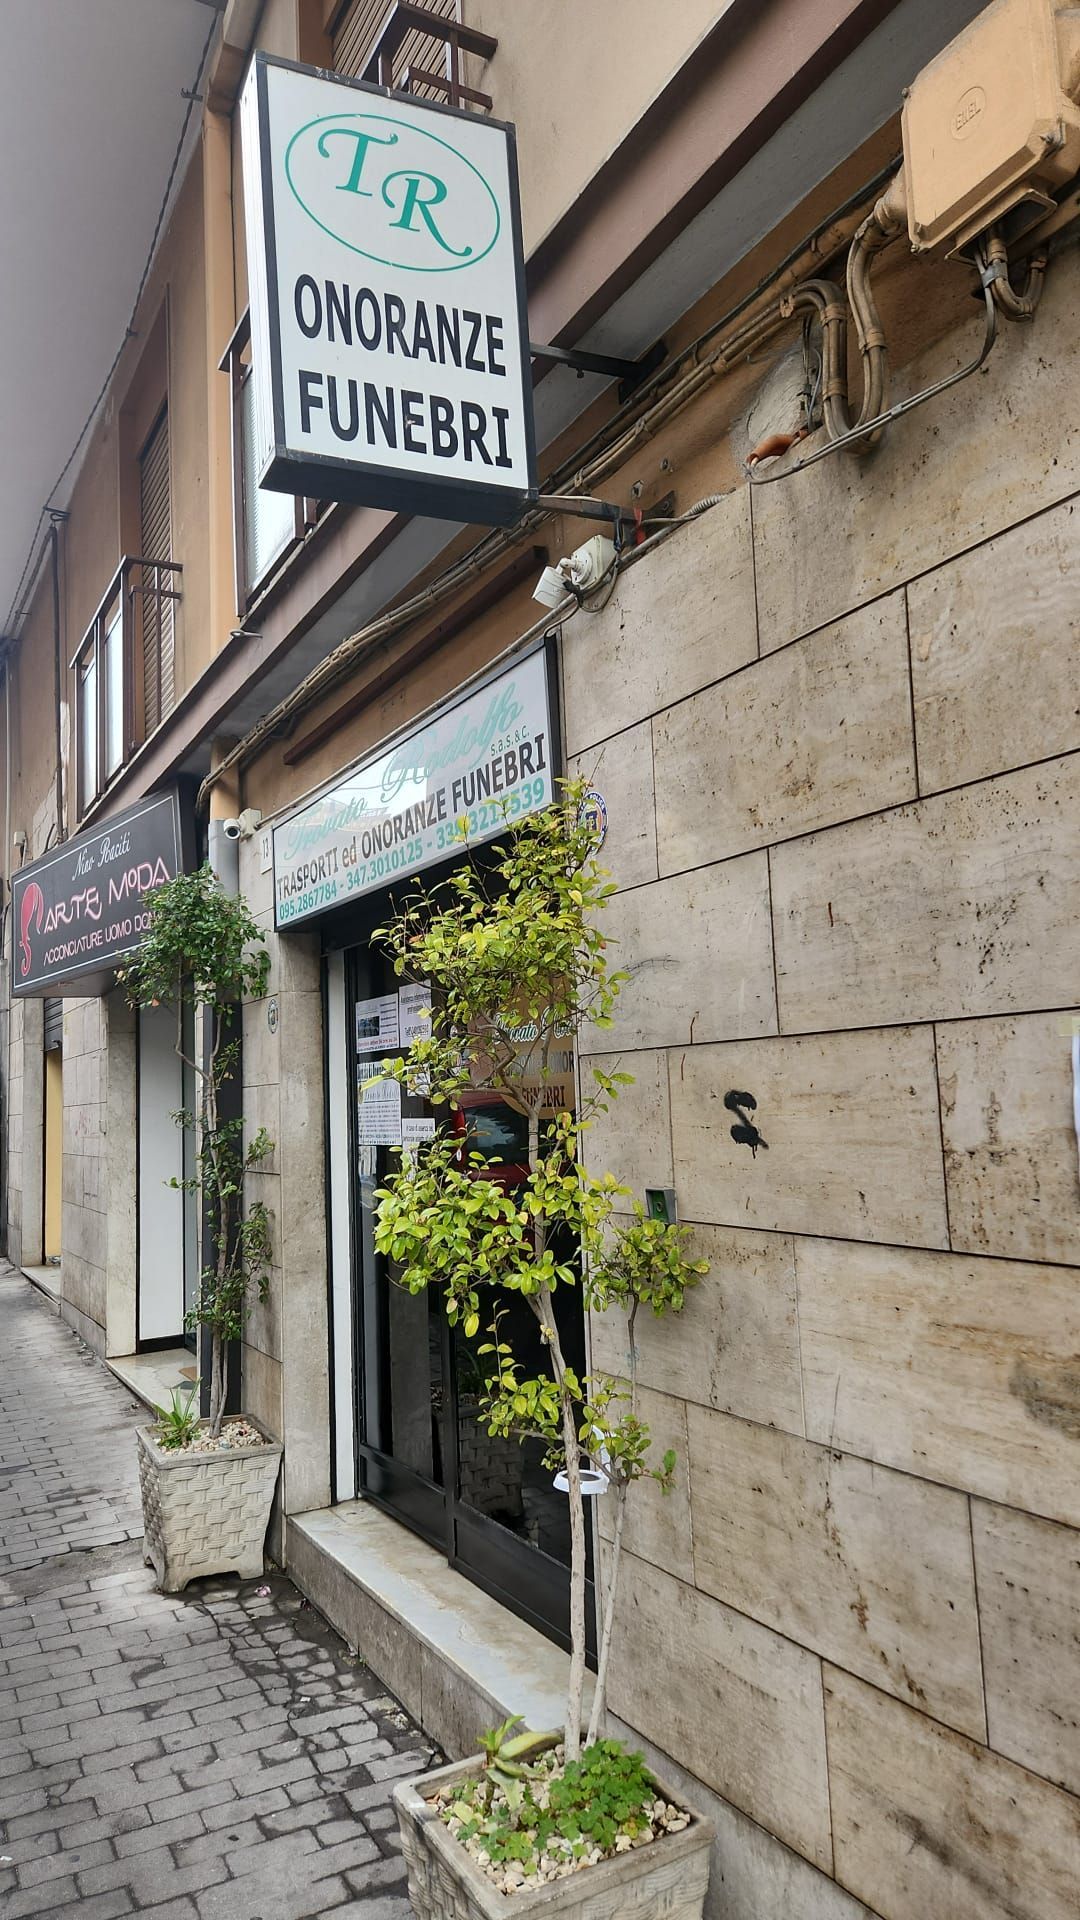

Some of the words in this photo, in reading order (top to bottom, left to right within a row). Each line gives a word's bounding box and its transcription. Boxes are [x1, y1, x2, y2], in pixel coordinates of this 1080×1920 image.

[294, 274, 506, 376] ONORANZE
[298, 369, 513, 469] FUNEBRI
[276, 846, 339, 901] TRASPORTI
[341, 835, 357, 868] ed
[361, 787, 447, 859] ONORANZE
[452, 733, 546, 813] FUNEBRI
[43, 886, 103, 934] ARTE
[279, 879, 337, 920] 095.2867784
[346, 837, 423, 891] 347.3010125
[105, 919, 132, 942] UOMO
